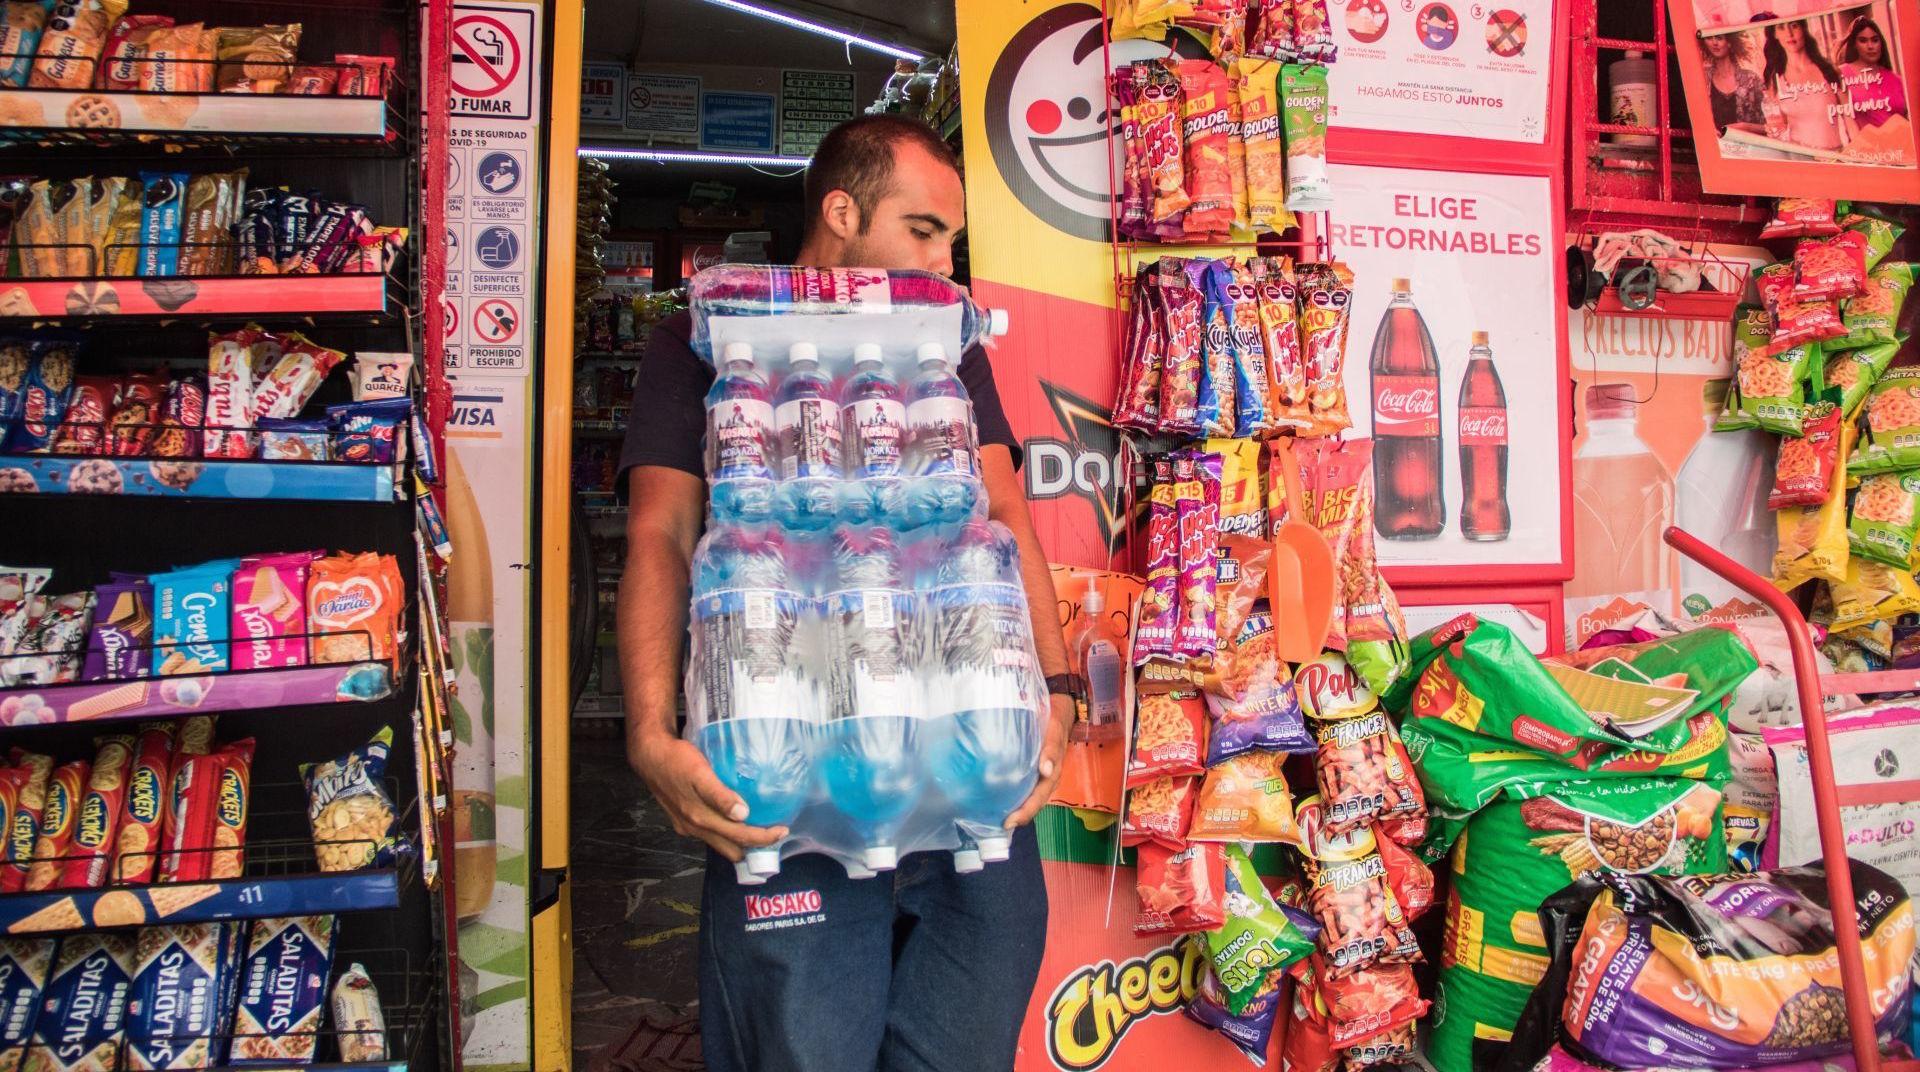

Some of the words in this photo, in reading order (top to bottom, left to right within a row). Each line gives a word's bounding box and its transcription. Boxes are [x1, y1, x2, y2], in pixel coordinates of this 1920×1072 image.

[1475, 7, 1482, 16] 3
[47, 36, 77, 80] Gamesa
[793, 80, 847, 88] SISMOS
[1446, 86, 1473, 94] DISTANCIA
[461, 98, 511, 113] FUMAR
[1286, 96, 1325, 108] GOLDEN
[1358, 85, 1420, 101] HAGAMOS
[1423, 92, 1453, 104] ESTO
[1455, 96, 1503, 108] JUNTOS
[788, 111, 847, 120] INCENDIOS
[1827, 95, 1892, 124] podemos
[449, 138, 487, 147] OVID-19
[461, 129, 472, 137] DE
[475, 129, 527, 139] SEGURIDAD
[1394, 194, 1478, 221] ELIGE
[1331, 223, 1542, 256] RETORNABLES
[473, 275, 519, 283] DESINFECTE
[473, 284, 520, 292] SUPERFICIES
[1265, 305, 1282, 321] 10
[1308, 311, 1325, 327] 10
[470, 349, 521, 358] PROHIBIDO
[477, 358, 514, 367] ESCUPIR
[365, 382, 405, 393] QUAKER
[1378, 388, 1436, 414] Coca-Cola
[452, 407, 495, 426] VISA
[1460, 416, 1505, 437] Coca-Cola
[1180, 485, 1200, 497] $15
[1324, 485, 1356, 507] BIG
[1182, 505, 1216, 542] HOT
[241, 609, 273, 669] remax
[219, 773, 241, 823] CRACKETS
[1847, 820, 1915, 845] ADULTO
[238, 885, 262, 904] $11
[744, 889, 822, 920] KOSAKO
[1858, 889, 1882, 910] kg
[1871, 895, 1894, 919] NETO
[745, 920, 773, 931] SABORES
[774, 919, 793, 928] PARIS
[1216, 931, 1252, 965] DONITAS
[1608, 930, 1640, 975] PRECIO
[267, 933, 303, 1030] SALADITAS
[1598, 978, 1612, 998] DE
[59, 956, 109, 1058] SALADITAS
[149, 952, 184, 1063] SALADITAS
[1584, 998, 1604, 1031] 20kg
[1600, 993, 1620, 1024] 23kg
